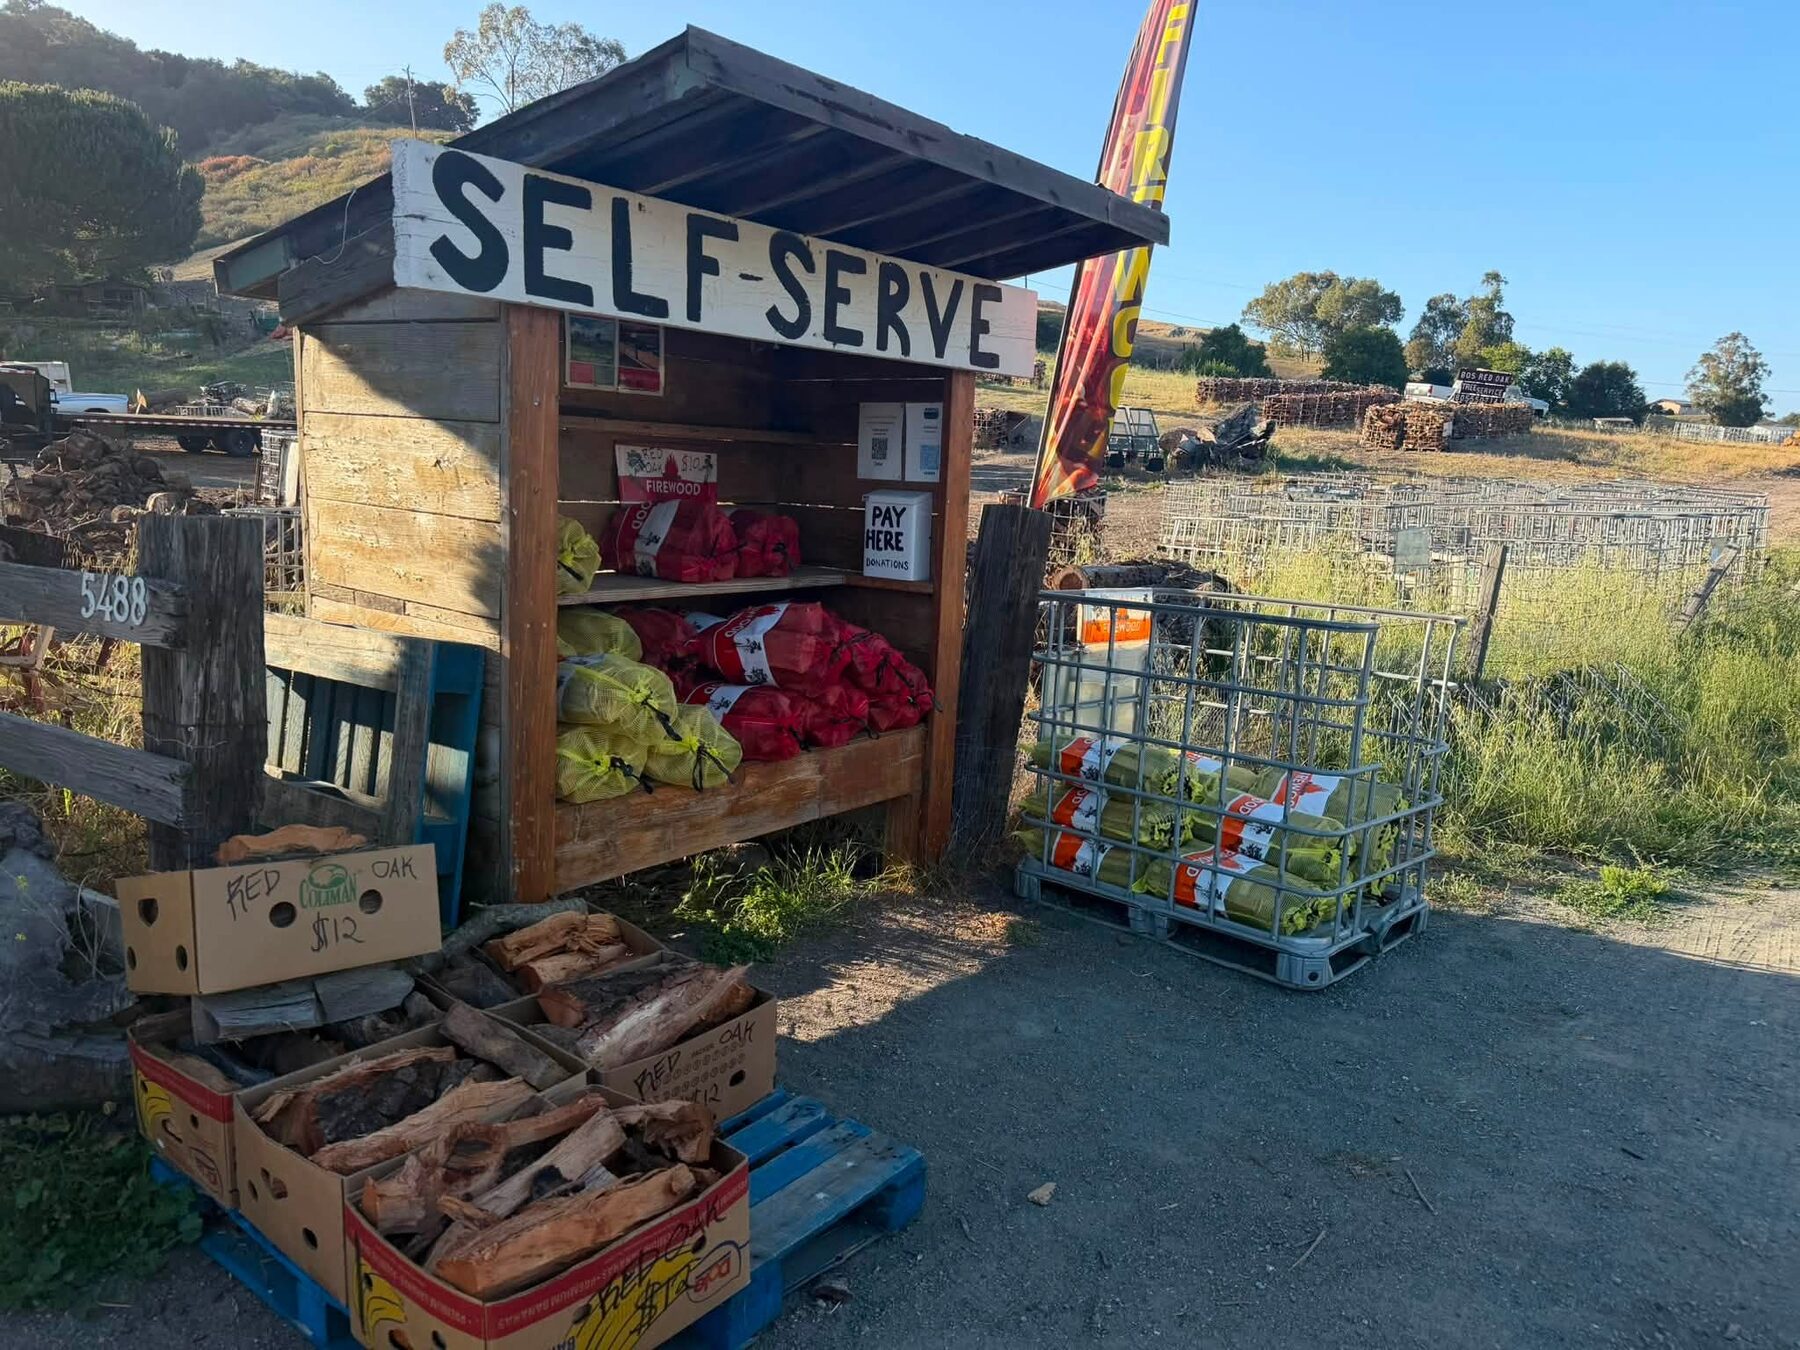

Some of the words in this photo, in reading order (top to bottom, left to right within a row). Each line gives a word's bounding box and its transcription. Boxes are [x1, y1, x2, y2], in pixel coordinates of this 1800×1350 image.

[430, 150, 1002, 368] SELF-SERVE
[1478, 373, 1493, 382] RED
[641, 448, 664, 460] RED
[646, 479, 701, 496] FIREWOOD
[872, 505, 907, 528] PAY
[865, 528, 904, 552] HERE
[866, 557, 909, 571] DONATIONS
[80, 568, 147, 626] 5488
[226, 869, 281, 922] RED
[371, 856, 417, 880] OAK
[311, 911, 365, 953] $12
[633, 1050, 681, 1105] RED
[719, 1020, 756, 1045] OAK
